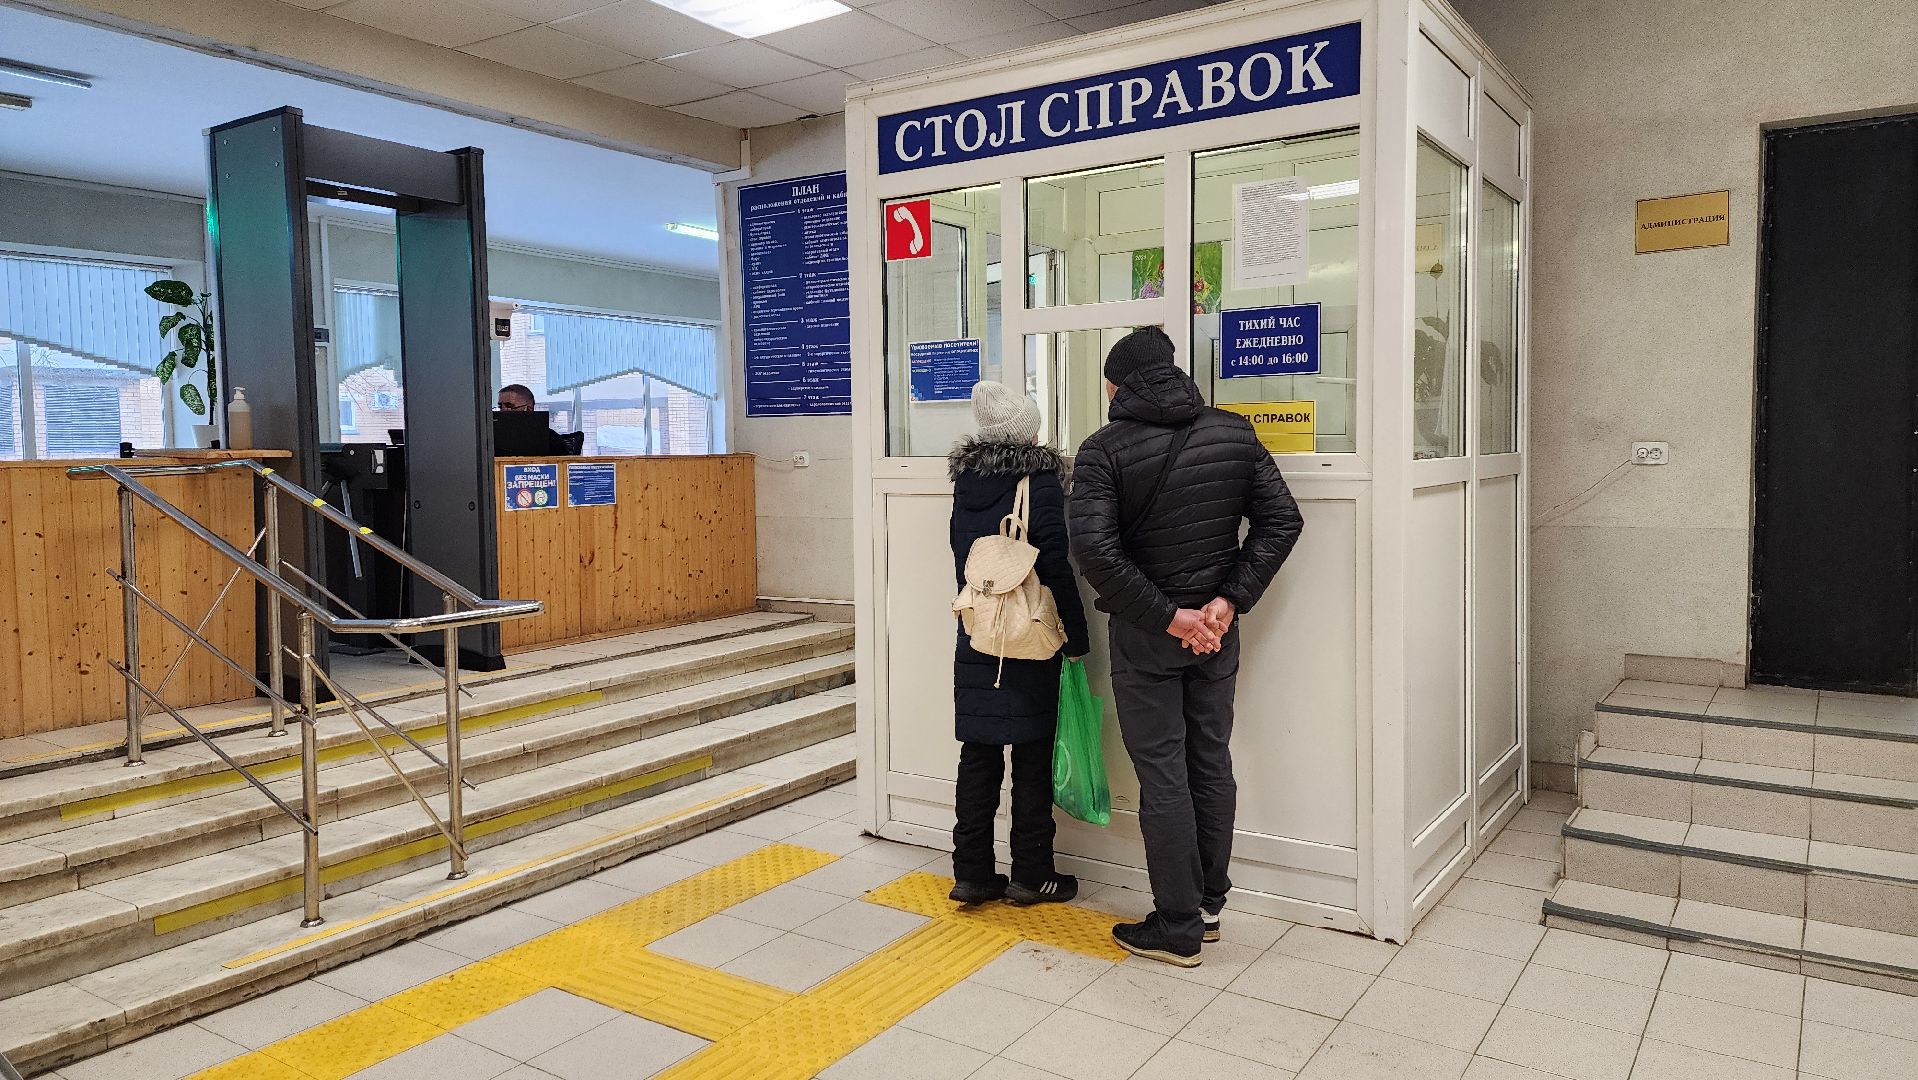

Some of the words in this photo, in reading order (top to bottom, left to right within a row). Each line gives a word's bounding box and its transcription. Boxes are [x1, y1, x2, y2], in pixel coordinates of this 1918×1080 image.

[894, 99, 1026, 162] СТОЛ
[1038, 40, 1334, 138] СПРАВОК
[791, 183, 820, 197] ПЛАН
[1640, 214, 1725, 230] АДМИНИСТРАЦИЯ
[1238, 315, 1276, 331] ТИХИЙ
[1278, 316, 1301, 328] ЧАС
[1235, 334, 1304, 349] ЕЖЕДНЕВНО
[1238, 354, 1264, 366] 14:00
[1267, 356, 1279, 366] до
[1281, 352, 1309, 364] 16:00
[1253, 412, 1311, 424] СПРАВОК
